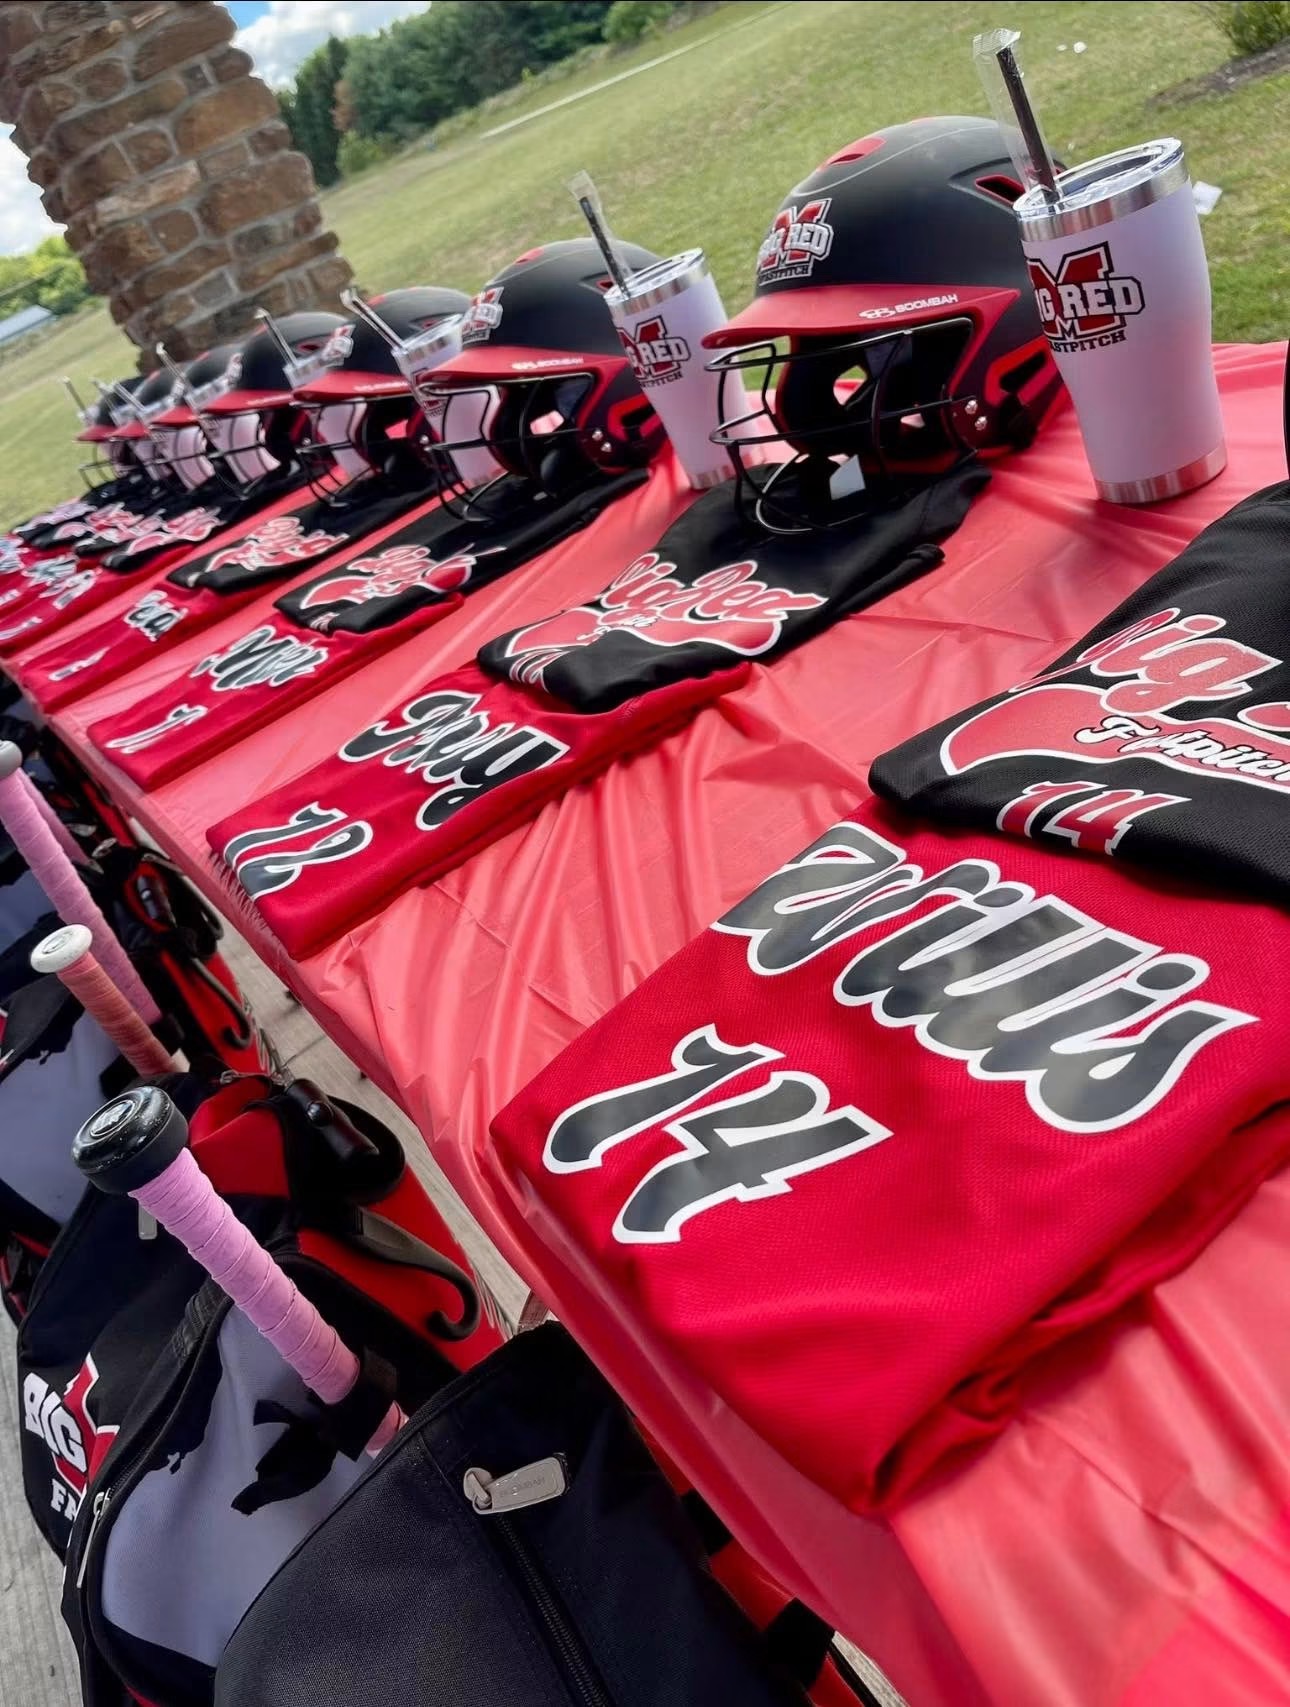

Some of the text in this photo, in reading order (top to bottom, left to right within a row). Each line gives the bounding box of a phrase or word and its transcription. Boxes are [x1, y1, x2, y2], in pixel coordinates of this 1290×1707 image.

[784, 222, 832, 258] RED
[895, 294, 958, 313] BOOMBAH
[1056, 277, 1145, 319] RED
[635, 336, 691, 366] RED
[996, 780, 1193, 857] 14
[710, 821, 1261, 1134] Willis
[542, 1023, 895, 1245] 14
[23, 1371, 88, 1473] BIG
